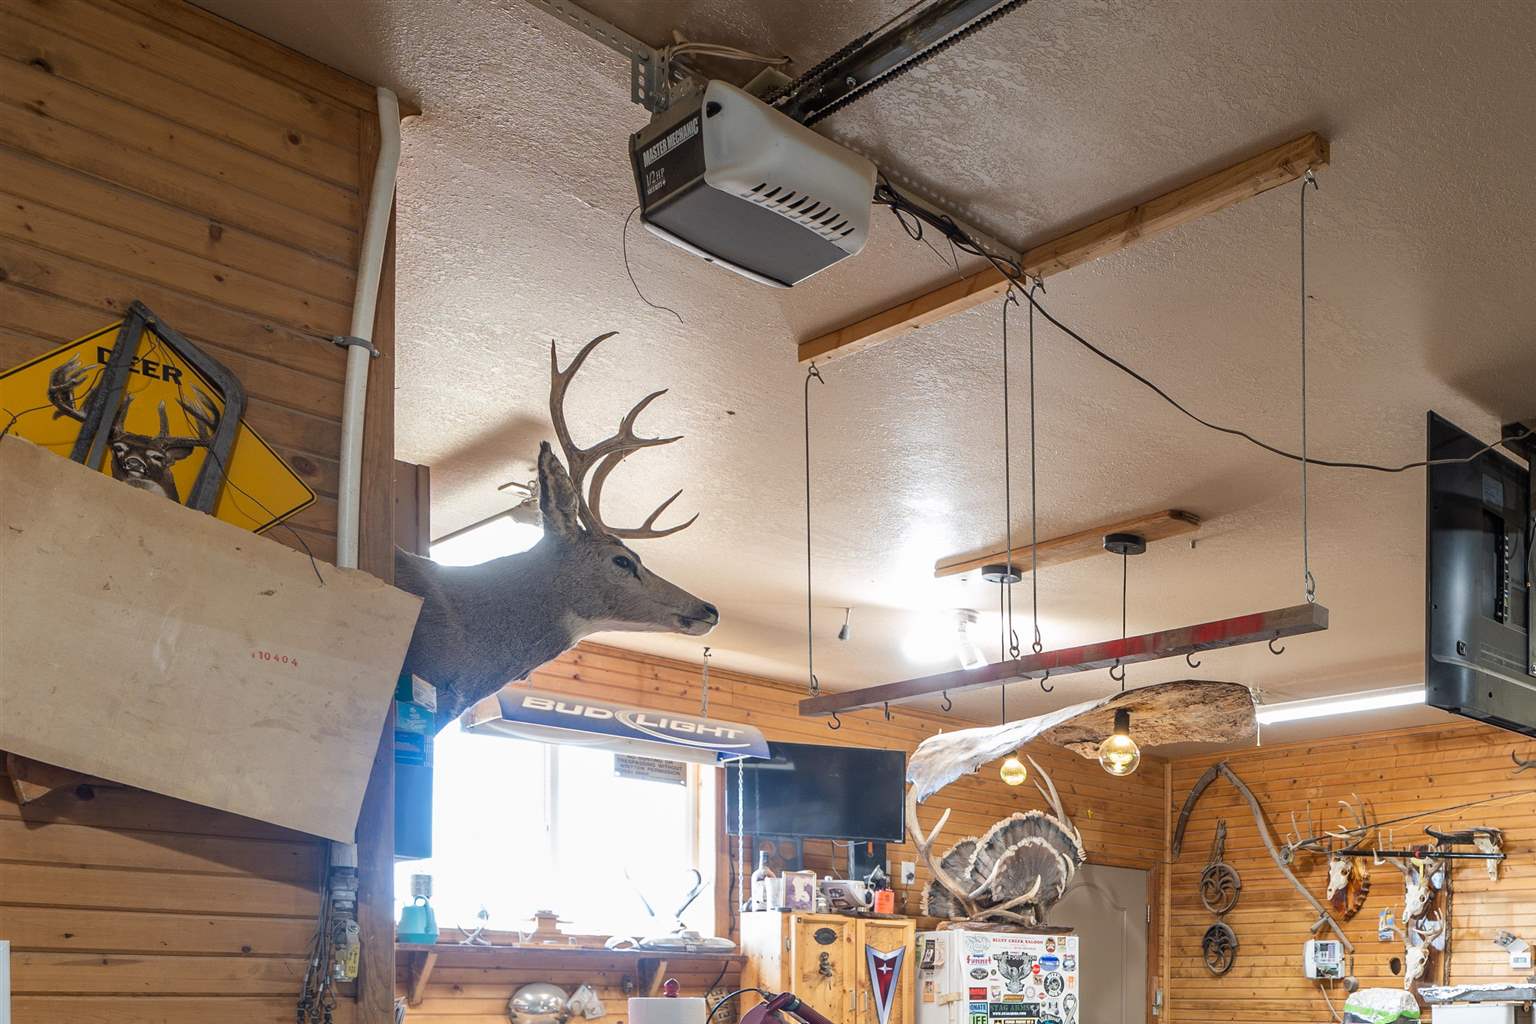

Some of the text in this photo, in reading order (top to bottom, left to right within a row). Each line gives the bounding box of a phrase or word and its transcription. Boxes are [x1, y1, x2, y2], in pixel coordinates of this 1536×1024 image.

[643, 117, 699, 168] MASTER MECHANIC
[521, 695, 744, 739] BUD LIGHT
